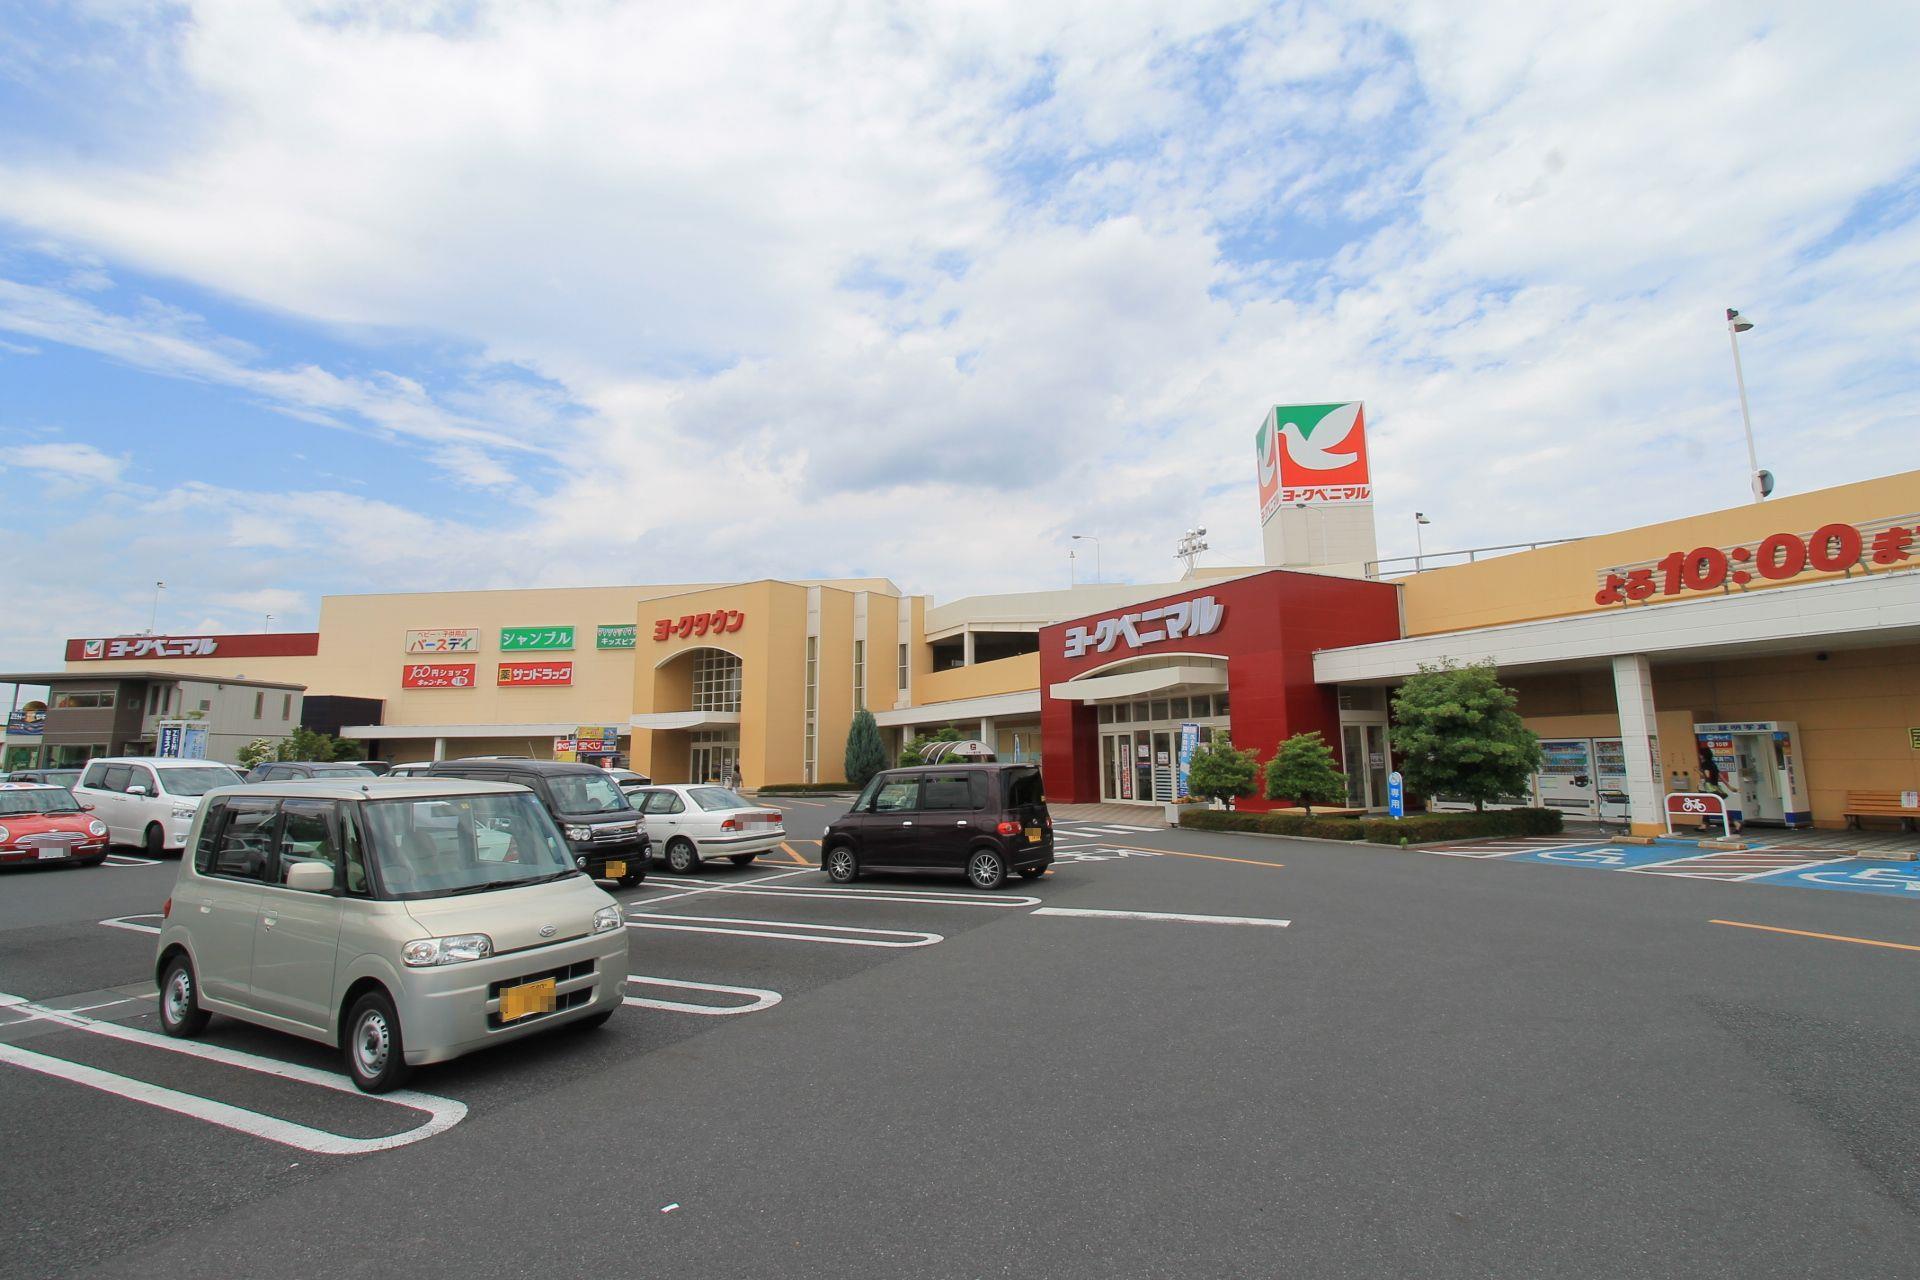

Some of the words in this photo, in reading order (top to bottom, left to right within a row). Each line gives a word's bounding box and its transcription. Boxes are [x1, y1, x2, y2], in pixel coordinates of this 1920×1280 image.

[1282, 487, 1370, 502] ヨークベニマル
[1595, 523, 1920, 605] よる10:00ま
[653, 609, 745, 641] ヨークタウン
[1064, 595, 1224, 658] ヨークベニマル
[410, 638, 472, 651] バースデイ
[502, 631, 571, 646] シャンブル
[109, 638, 218, 657] ヨークベニマル
[513, 667, 571, 680] サンドラッグ
